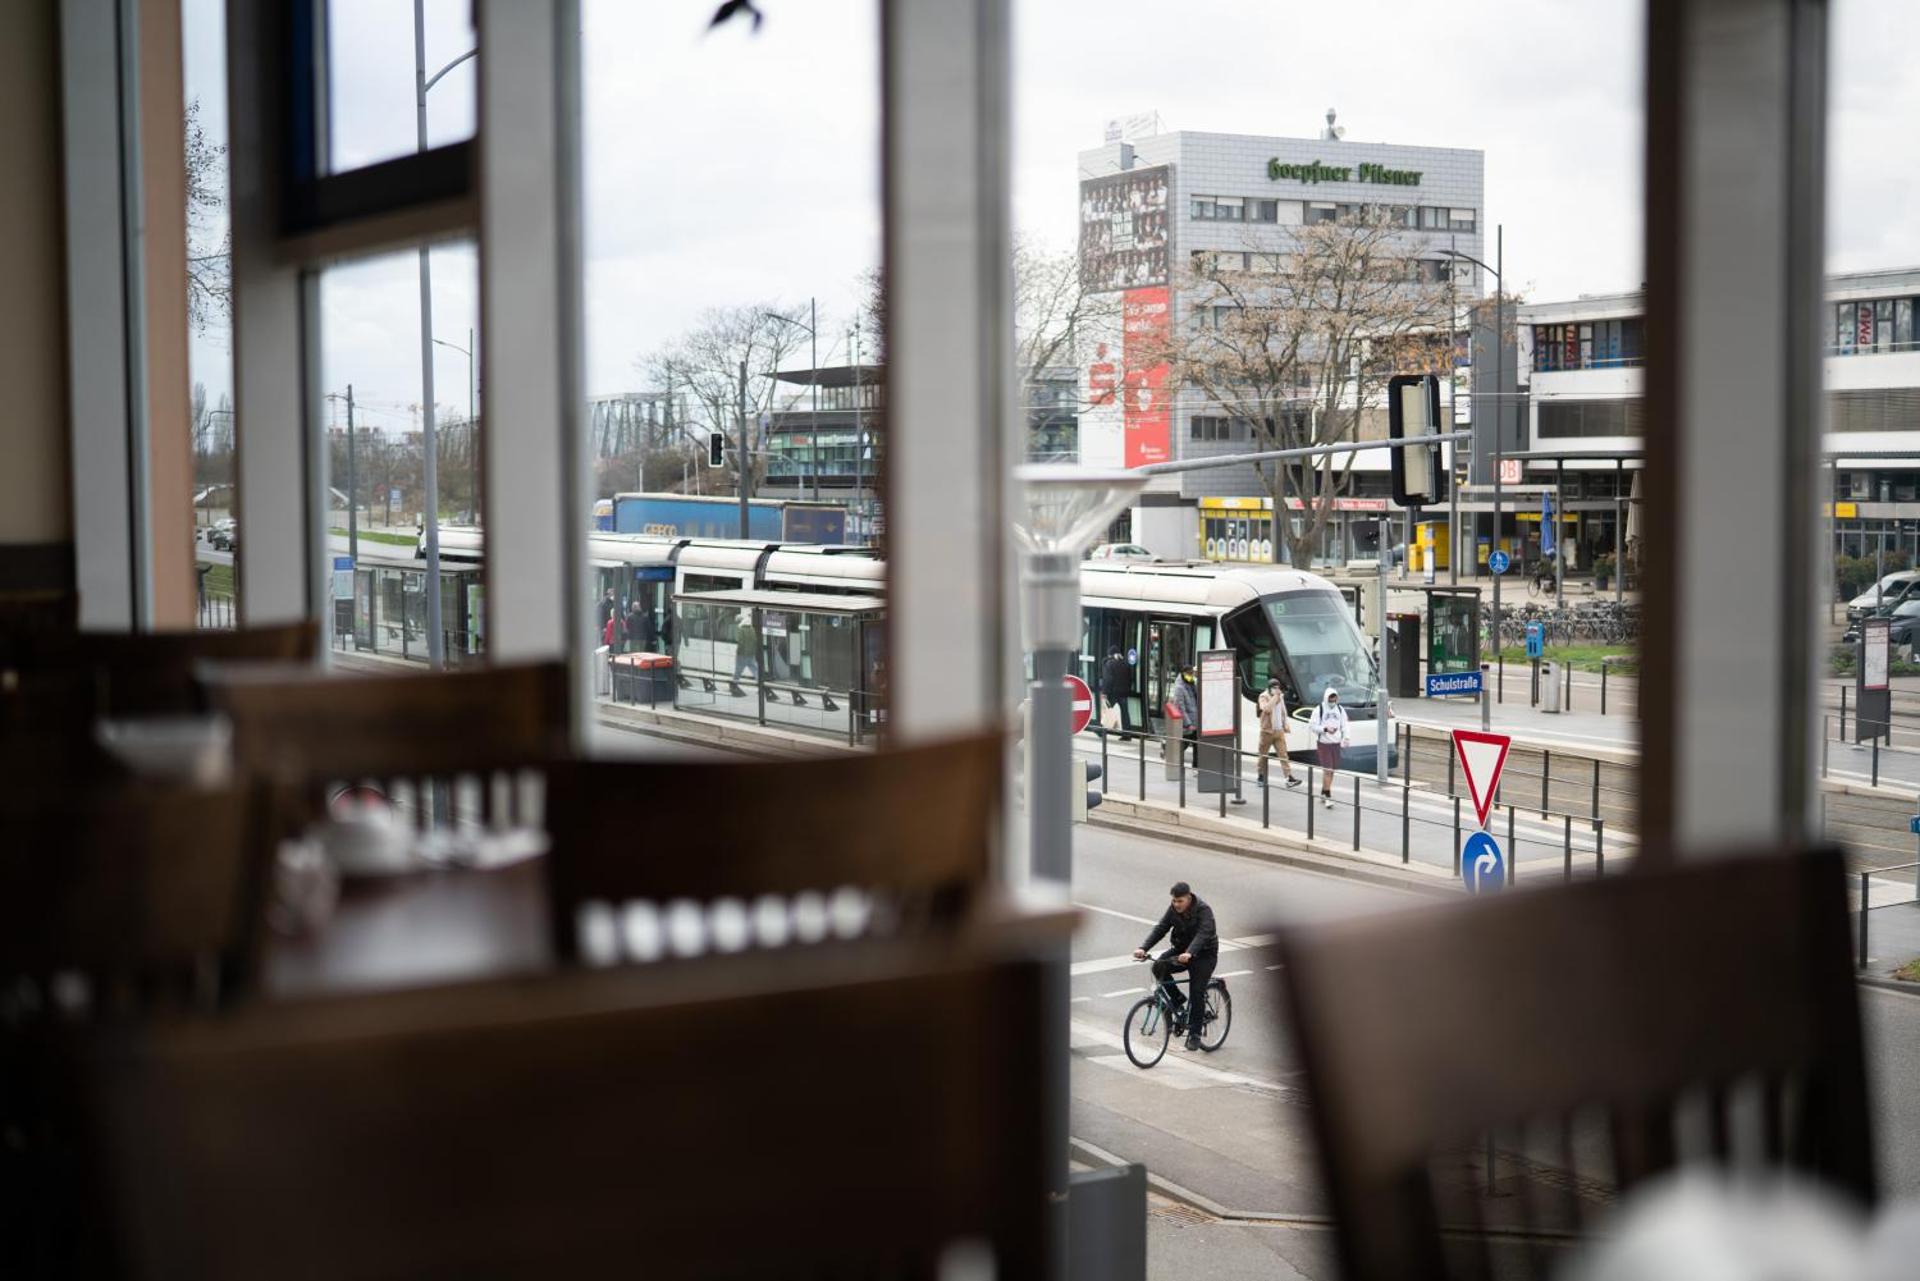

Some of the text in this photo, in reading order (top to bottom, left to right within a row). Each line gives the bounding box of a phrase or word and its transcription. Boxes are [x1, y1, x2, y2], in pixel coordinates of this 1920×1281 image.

[1359, 162, 1423, 186] Pilsner
[1860, 307, 1872, 345] PMU
[1430, 676, 1478, 692] Schulstraße
